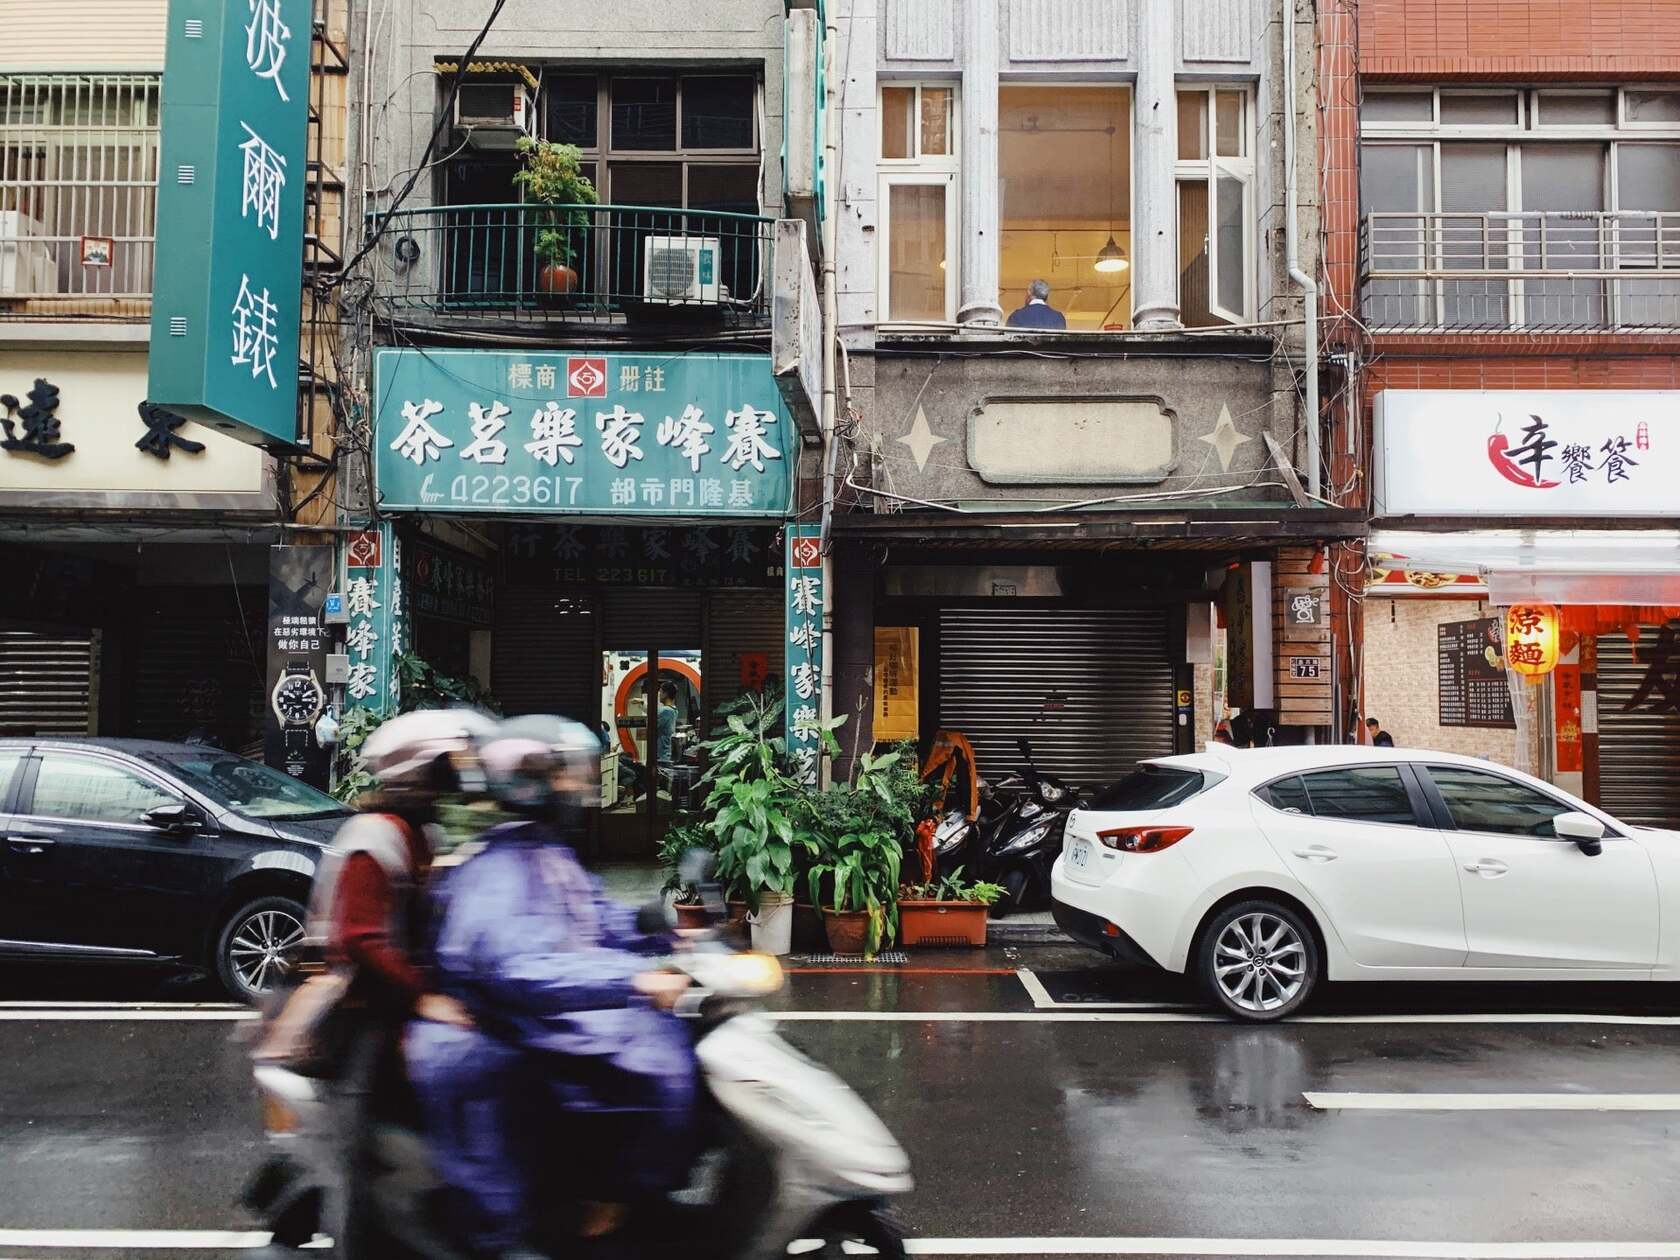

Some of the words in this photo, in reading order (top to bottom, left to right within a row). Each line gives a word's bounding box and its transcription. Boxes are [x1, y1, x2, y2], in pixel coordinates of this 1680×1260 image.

[451, 475, 583, 504] 4223617
[609, 477, 754, 506] 基隆門市部
[278, 639, 320, 650] 做你自己
[1300, 666, 1316, 677] 75
